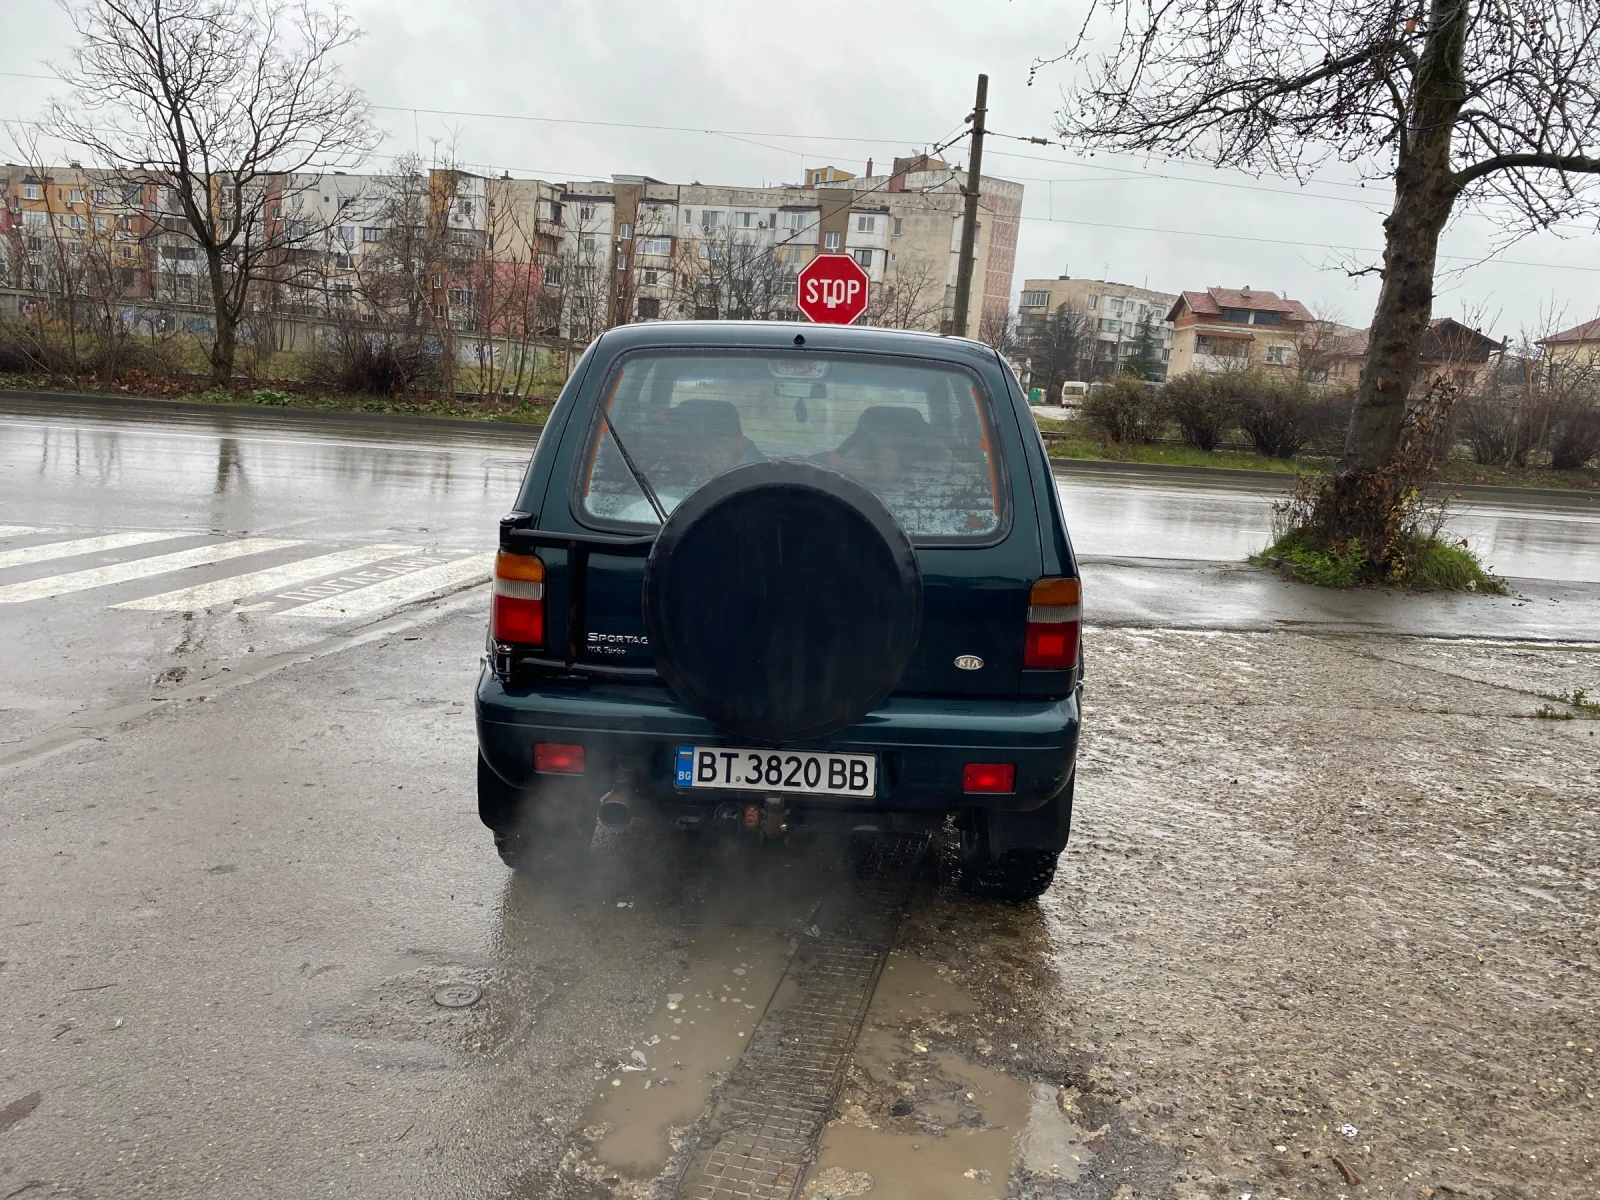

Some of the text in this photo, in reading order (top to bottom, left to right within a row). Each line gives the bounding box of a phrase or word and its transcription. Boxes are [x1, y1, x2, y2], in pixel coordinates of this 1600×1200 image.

[806, 278, 860, 305] STOP
[587, 632, 648, 644] SPORTAG
[958, 658, 980, 668] KIA
[678, 770, 692, 781] BG
[697, 751, 869, 791] BT 3820 BB
